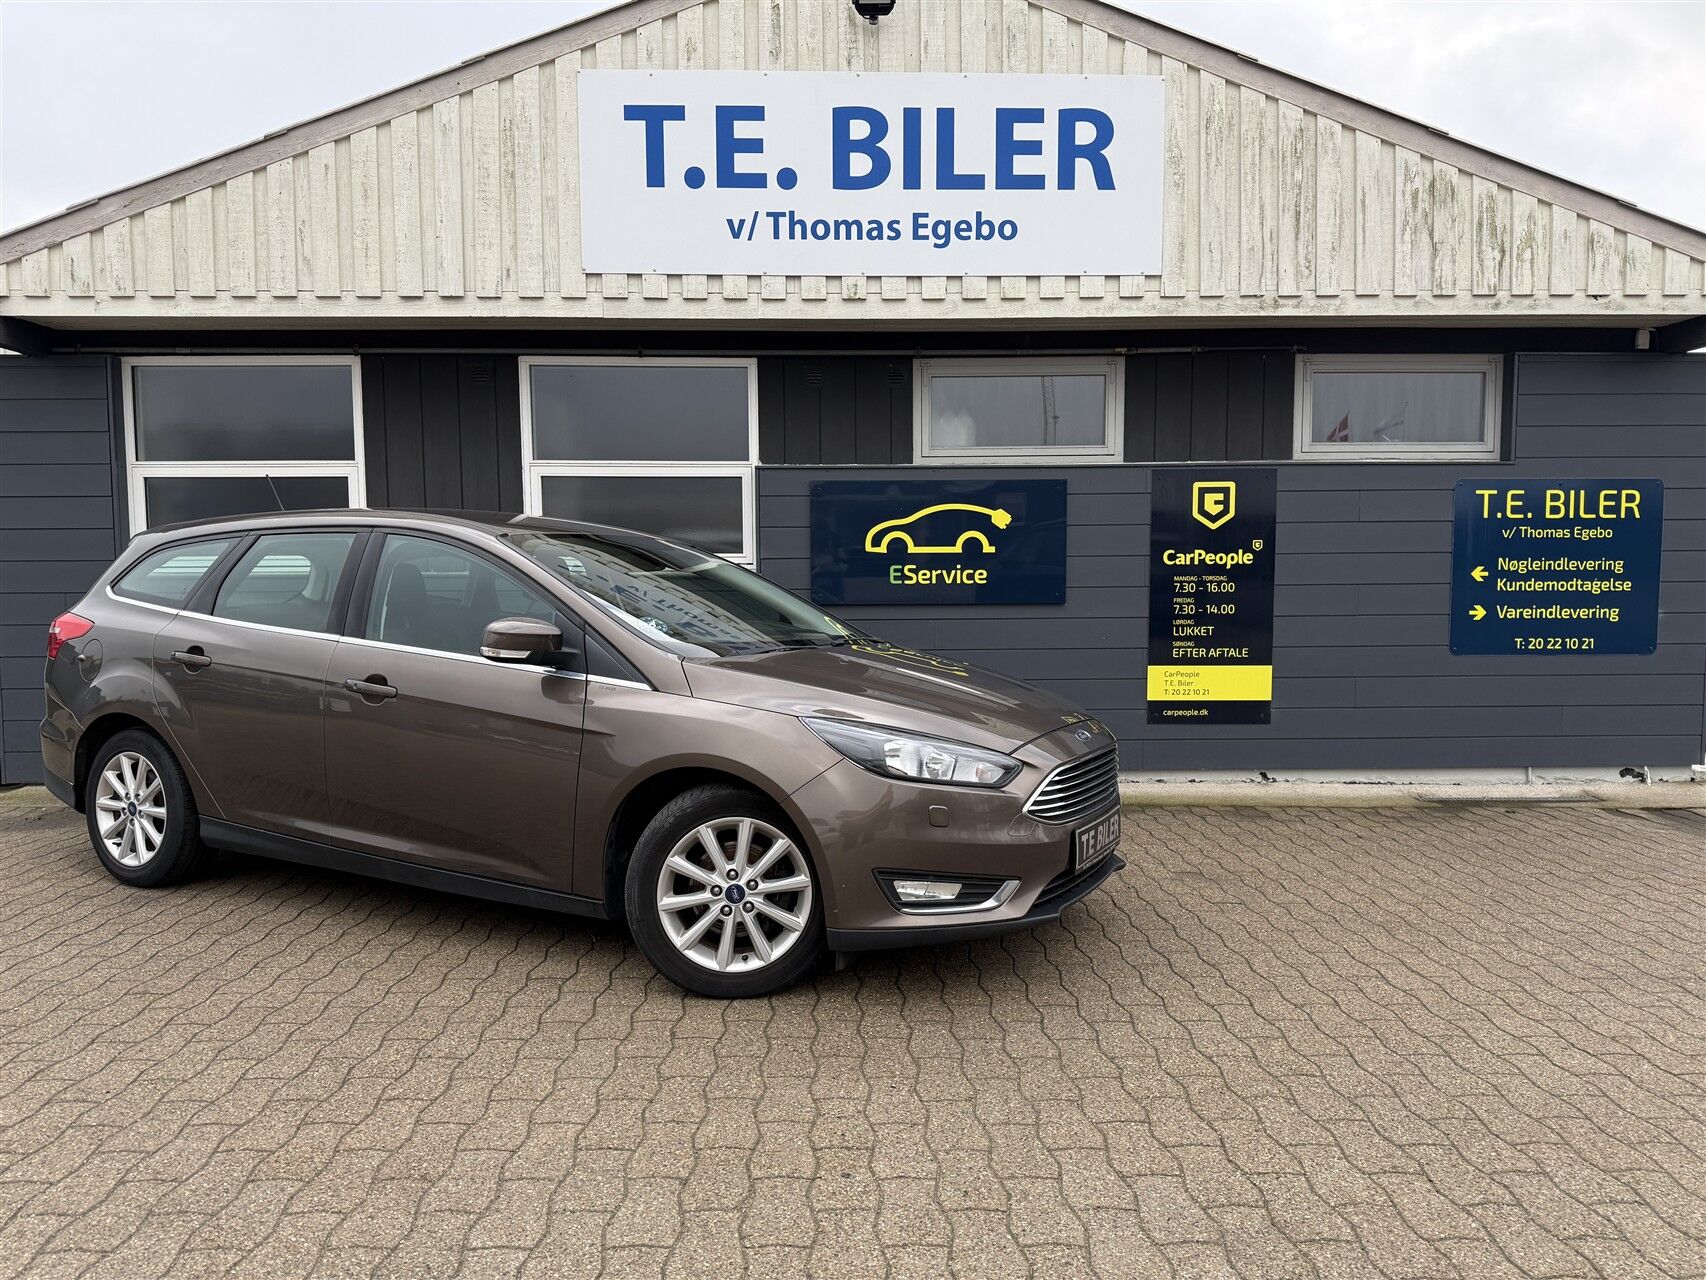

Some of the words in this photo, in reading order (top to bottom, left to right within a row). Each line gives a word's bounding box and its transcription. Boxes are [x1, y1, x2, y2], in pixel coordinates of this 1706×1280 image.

[623, 104, 798, 191] T.E.
[832, 105, 1117, 191] BILER
[726, 211, 759, 242] v/
[766, 210, 901, 241] Thomas
[912, 211, 1018, 249] Egebo
[1475, 489, 1533, 519] T.E.
[1545, 489, 1641, 519] BILER
[1502, 527, 1517, 539] v/
[1519, 526, 1571, 539] Thomas
[1574, 526, 1613, 541] Egebo
[1162, 549, 1254, 569] CarPeople
[1497, 557, 1625, 574] Nøgleindlevering
[889, 564, 988, 585] EService
[1173, 582, 1196, 593] 7.30
[1206, 582, 1236, 593] 16.00
[1496, 578, 1632, 594] Kundemodtagelse
[1173, 604, 1196, 615] 7.30
[1205, 604, 1236, 615] 14.00
[1496, 604, 1620, 622] Vareindlevering
[1173, 626, 1215, 637] LUKKET
[1514, 638, 1525, 650] T:
[1528, 638, 1544, 650] 20
[1546, 638, 1562, 650] 22
[1565, 638, 1579, 650] 10
[1581, 638, 1595, 650] 21
[1172, 648, 1207, 658] EFTER
[1208, 648, 1249, 658] AFTALE
[1164, 671, 1200, 679] CarPeople
[1162, 708, 1209, 717] carpeople.dk
[1097, 813, 1119, 851] BILER
